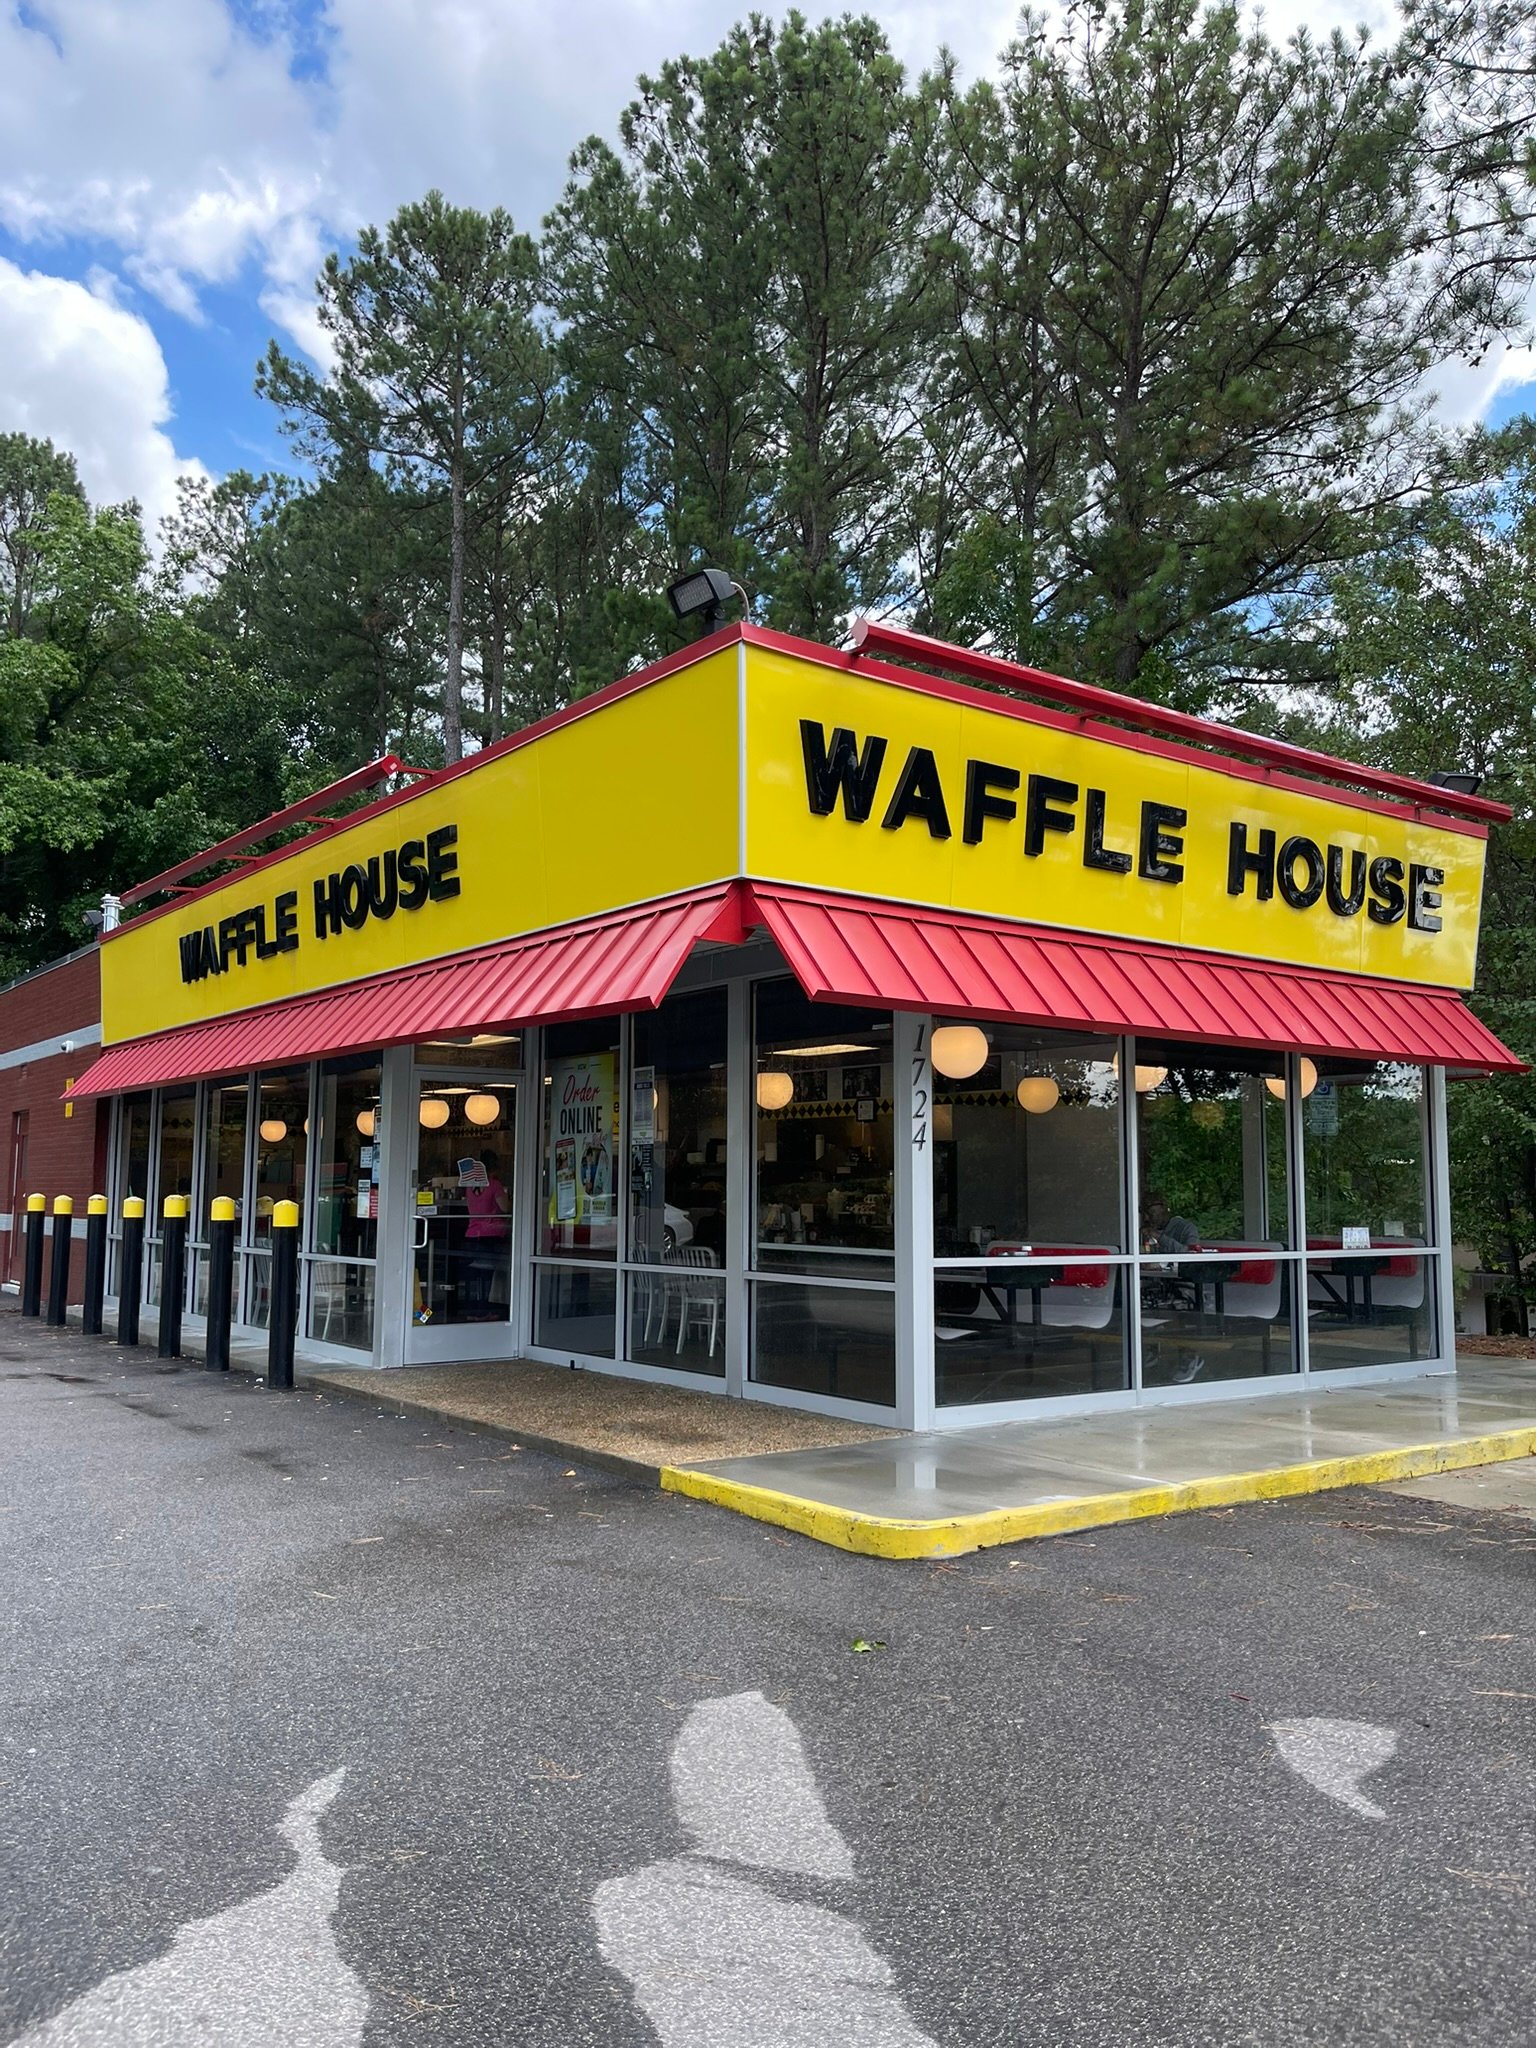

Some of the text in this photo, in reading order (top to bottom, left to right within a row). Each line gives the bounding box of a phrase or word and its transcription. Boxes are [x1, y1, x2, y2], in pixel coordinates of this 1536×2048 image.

[799, 720, 1445, 933] WAFFLE HOUSE
[179, 824, 460, 984] WAFFLE HOUSE
[560, 1106, 602, 1135] ONLINE
[563, 1074, 600, 1105] Order
[911, 1023, 928, 1152] 1724
